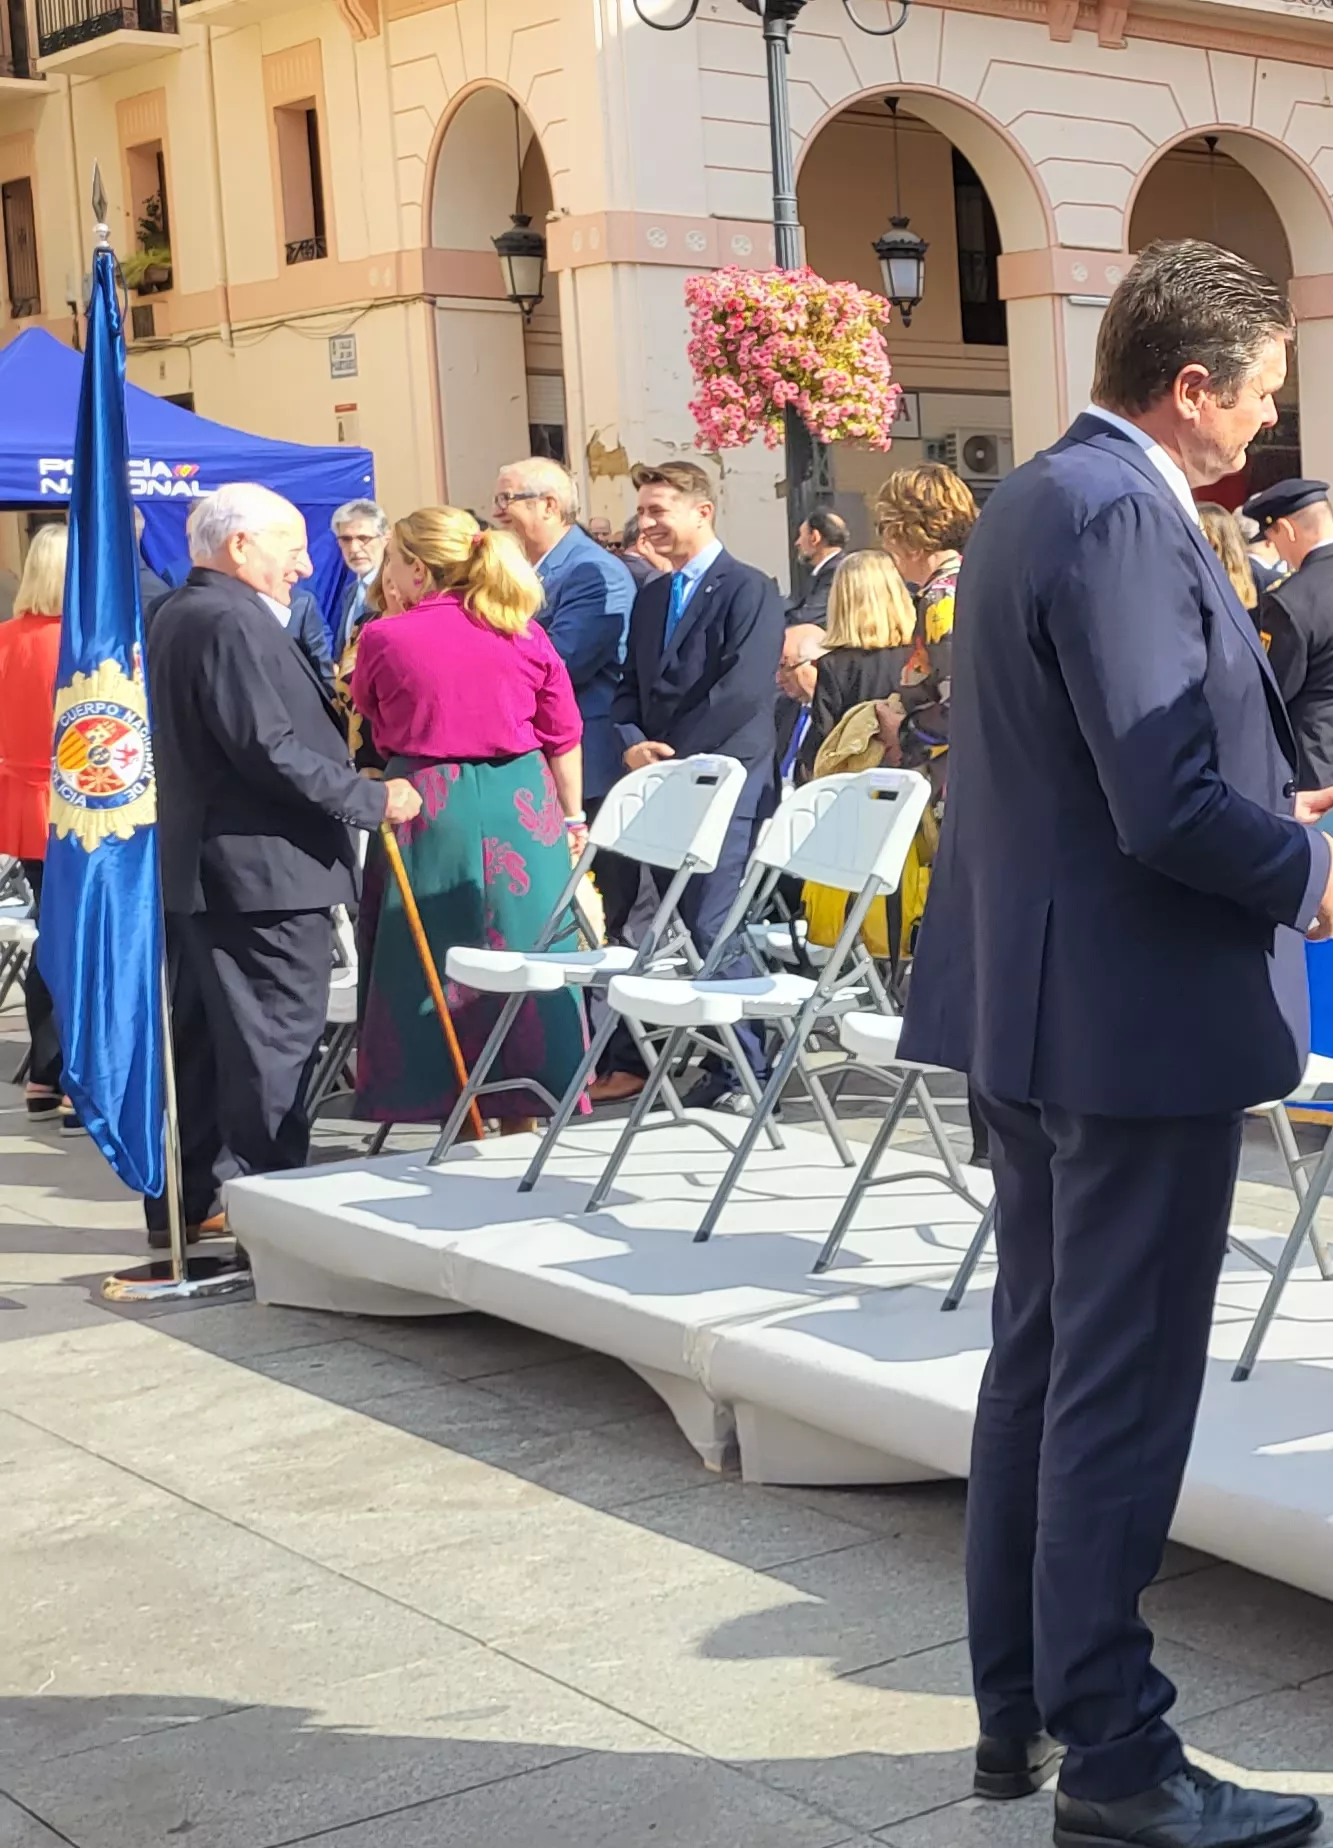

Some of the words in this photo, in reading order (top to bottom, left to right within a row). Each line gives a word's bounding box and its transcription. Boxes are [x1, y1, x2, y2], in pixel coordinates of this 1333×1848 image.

[38, 458, 172, 479] PCÍA
[40, 477, 217, 498] NONAL
[60, 702, 119, 727] CUERPO
[52, 756, 87, 808] LICIA
[123, 782, 146, 802] DE
